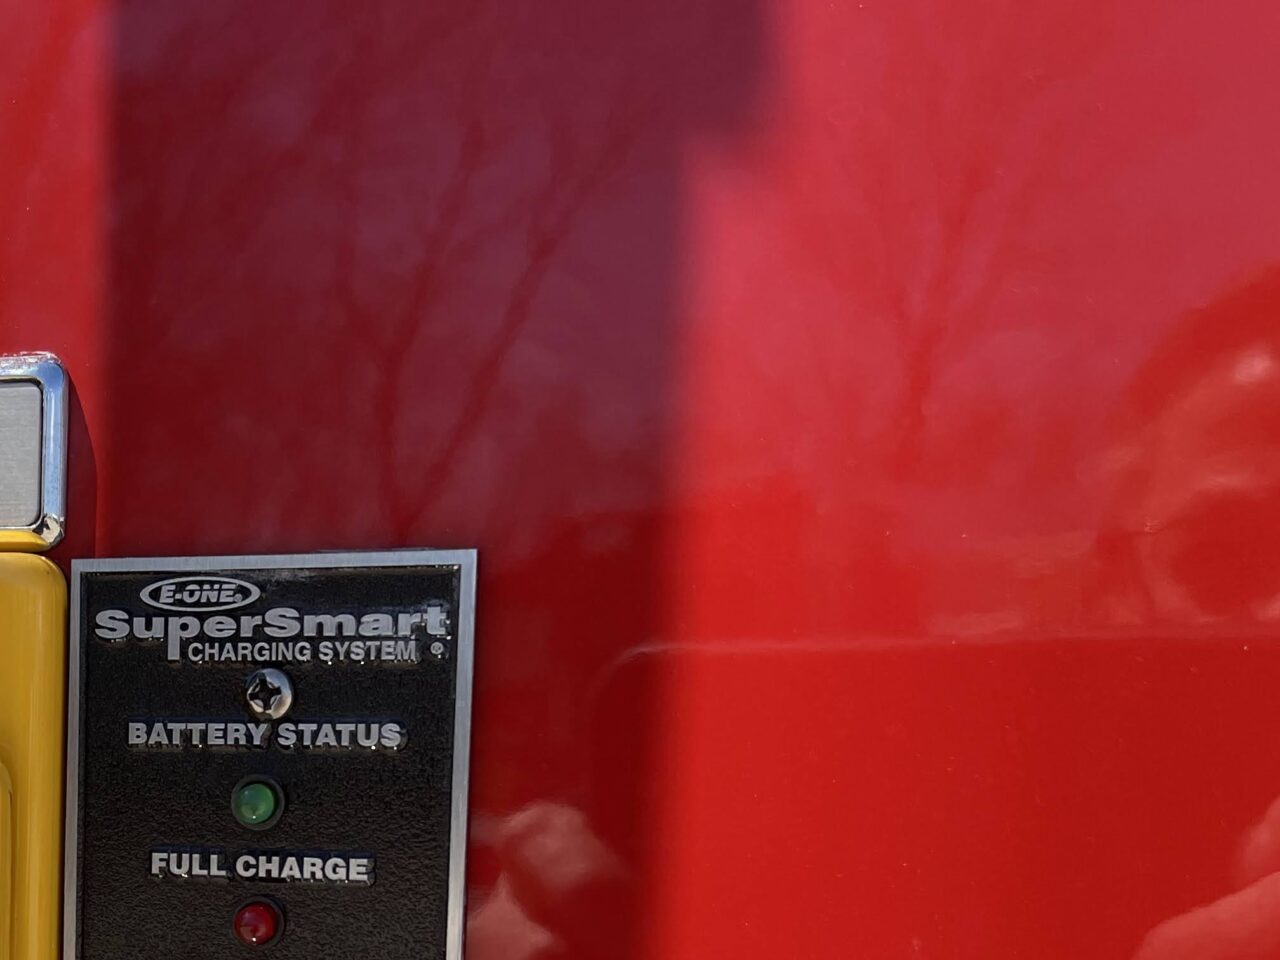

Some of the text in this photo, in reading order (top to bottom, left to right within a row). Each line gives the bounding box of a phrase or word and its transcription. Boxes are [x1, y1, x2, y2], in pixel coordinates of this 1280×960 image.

[94, 606, 447, 661] SuperSmart
[188, 640, 417, 662] CHARGING SYSTEM
[128, 722, 402, 747] BATTERY STATUS
[151, 852, 370, 882] FULL CHARGE
